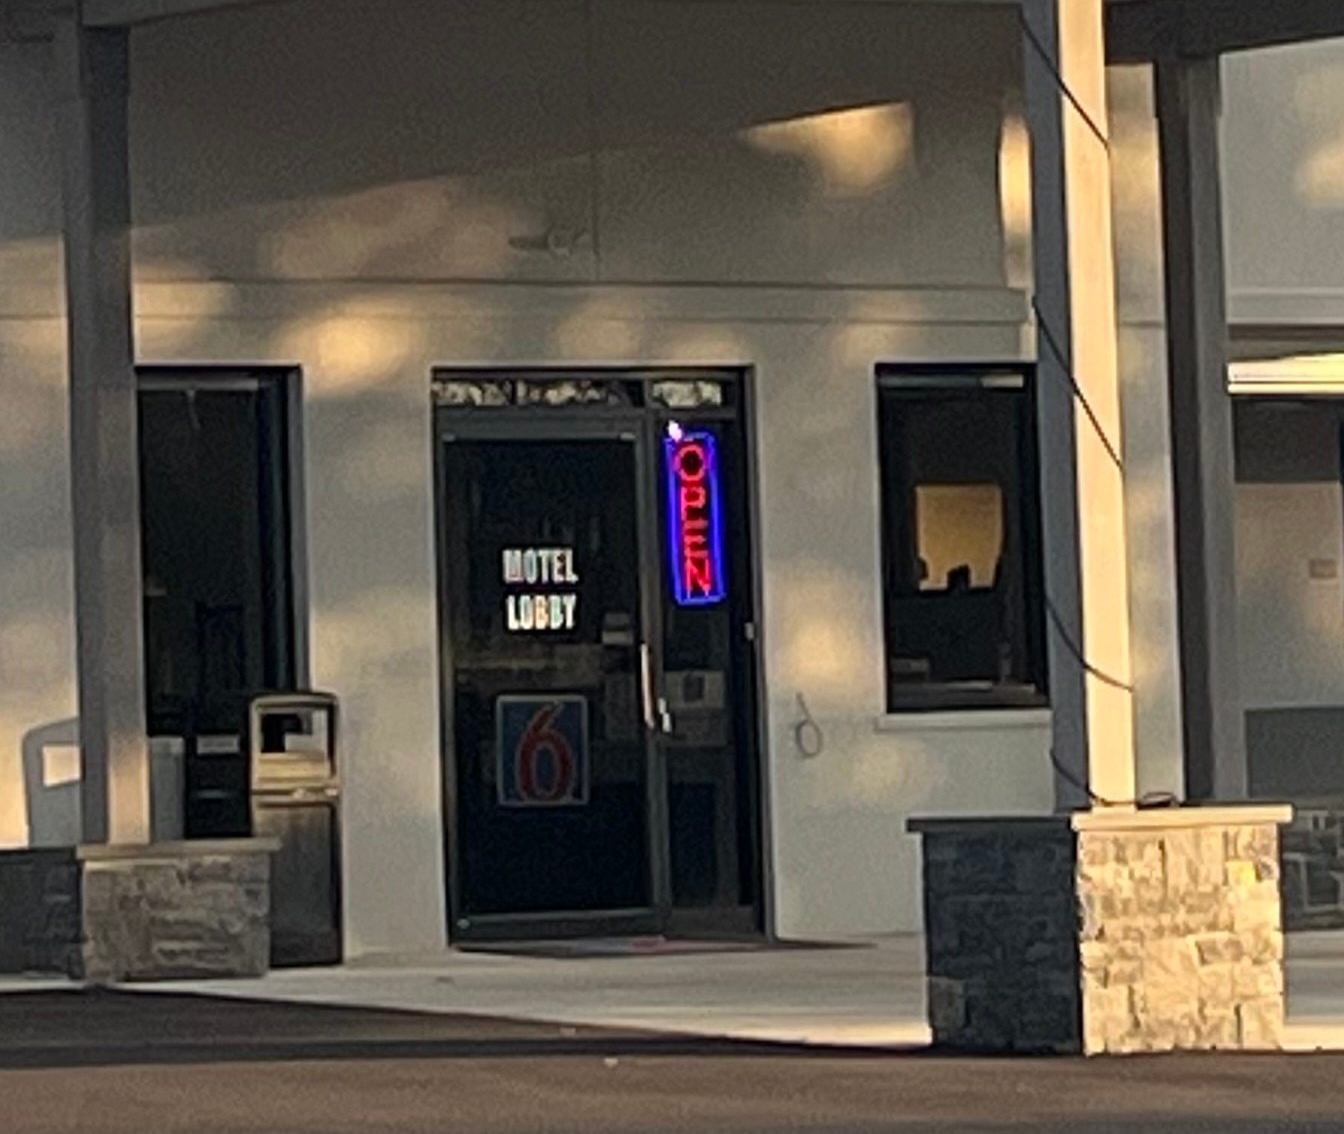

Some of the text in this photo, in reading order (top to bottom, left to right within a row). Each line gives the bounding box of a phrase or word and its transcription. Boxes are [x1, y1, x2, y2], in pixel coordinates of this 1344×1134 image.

[674, 444, 712, 598] OPEN
[502, 548, 579, 584] MOTEL
[505, 593, 577, 630] LOBBY
[515, 702, 573, 803] 6
